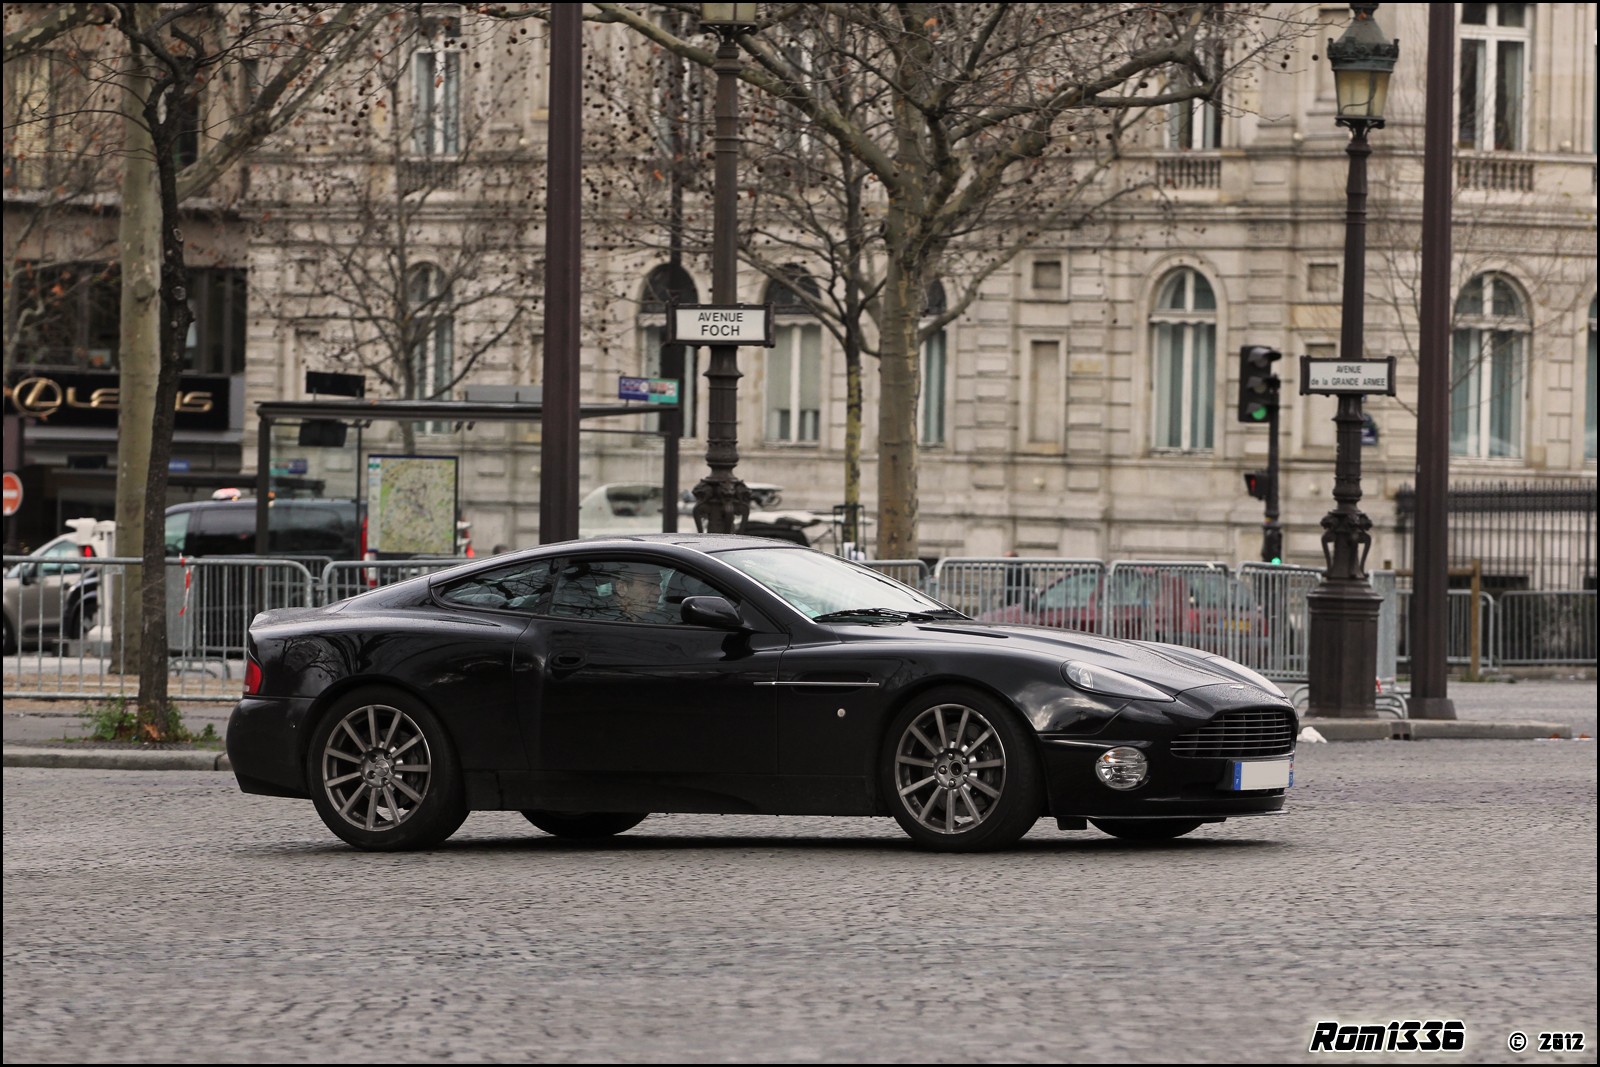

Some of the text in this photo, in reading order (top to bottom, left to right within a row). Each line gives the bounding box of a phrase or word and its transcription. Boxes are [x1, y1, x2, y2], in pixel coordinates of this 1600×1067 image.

[698, 312, 744, 323] AVENUE
[701, 325, 740, 336] FOCH
[1336, 365, 1362, 374] AVENUE
[1311, 377, 1385, 386] de la GRANDE ARMEE
[66, 387, 213, 413] LES
